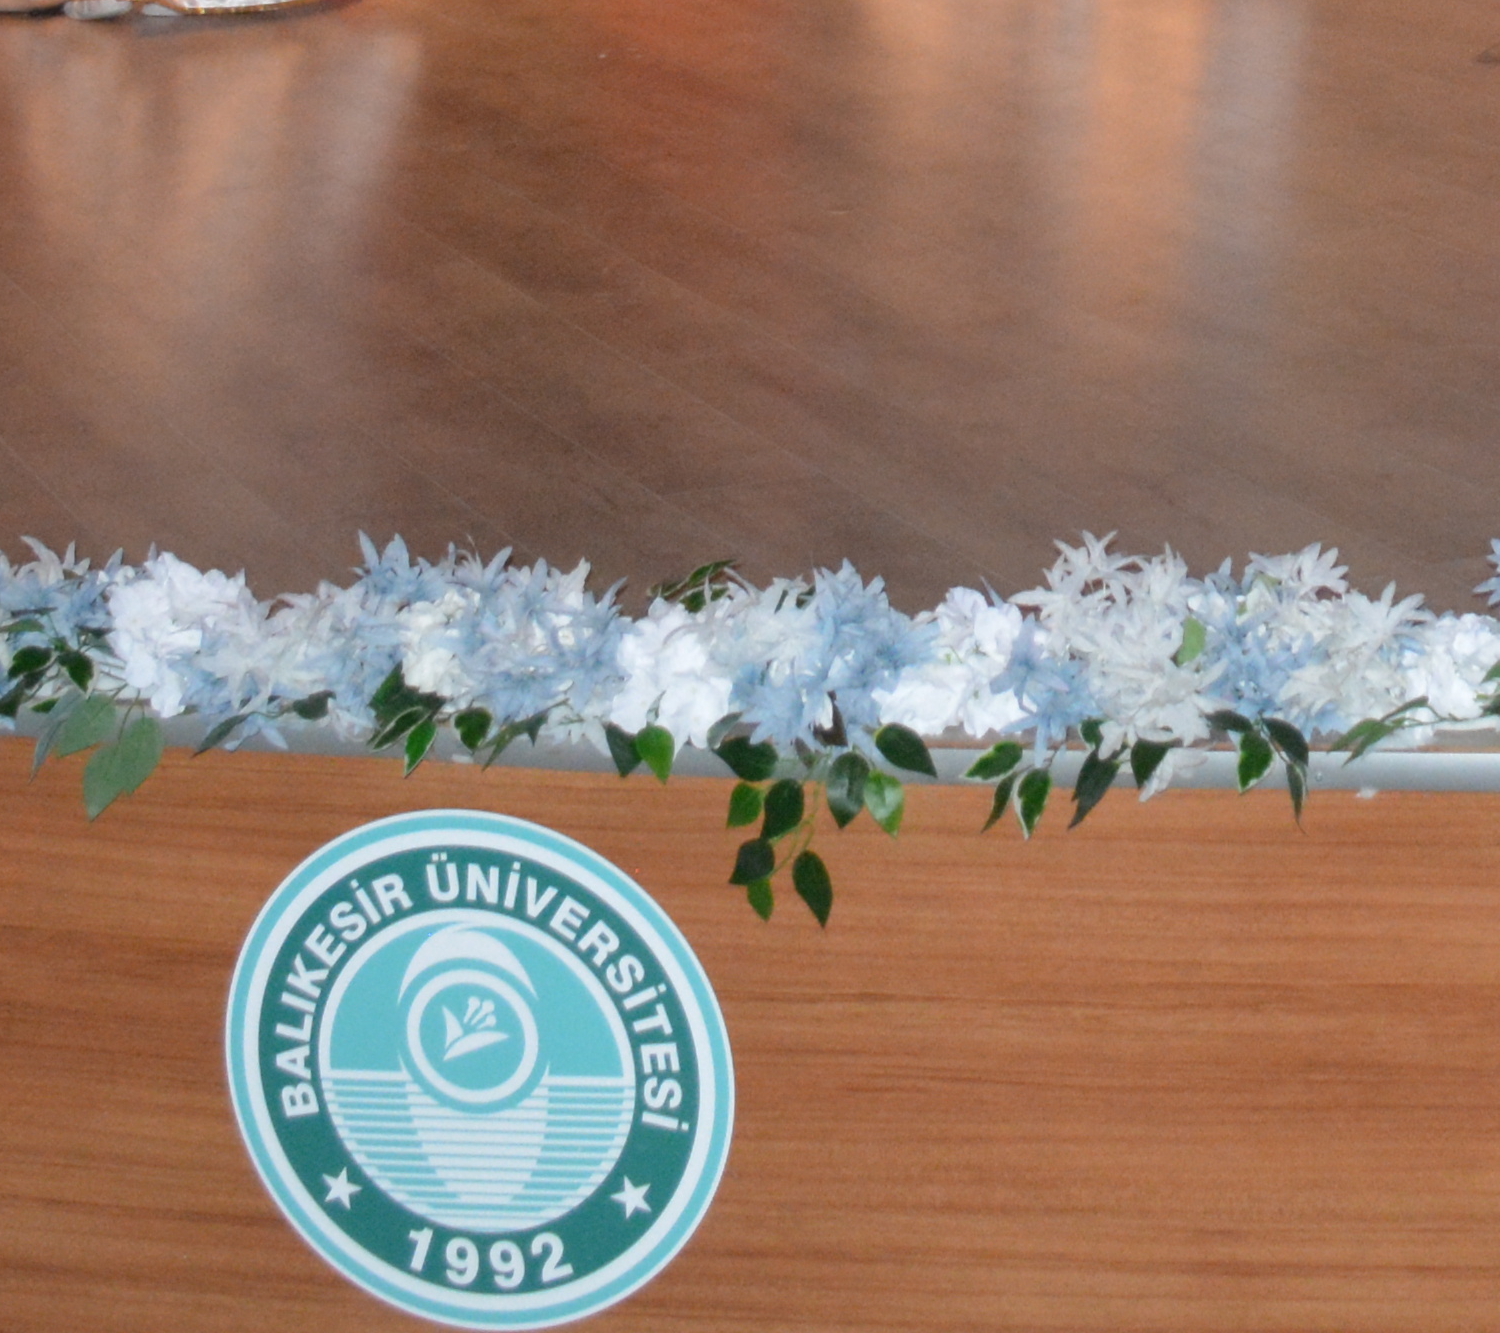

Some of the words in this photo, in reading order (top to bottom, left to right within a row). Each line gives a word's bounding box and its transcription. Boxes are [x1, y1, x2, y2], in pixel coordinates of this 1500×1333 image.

[274, 871, 414, 1119] BALIKESİR
[425, 852, 690, 1133] ÜNİVERSİTESİ
[408, 1226, 575, 1289] 1992
